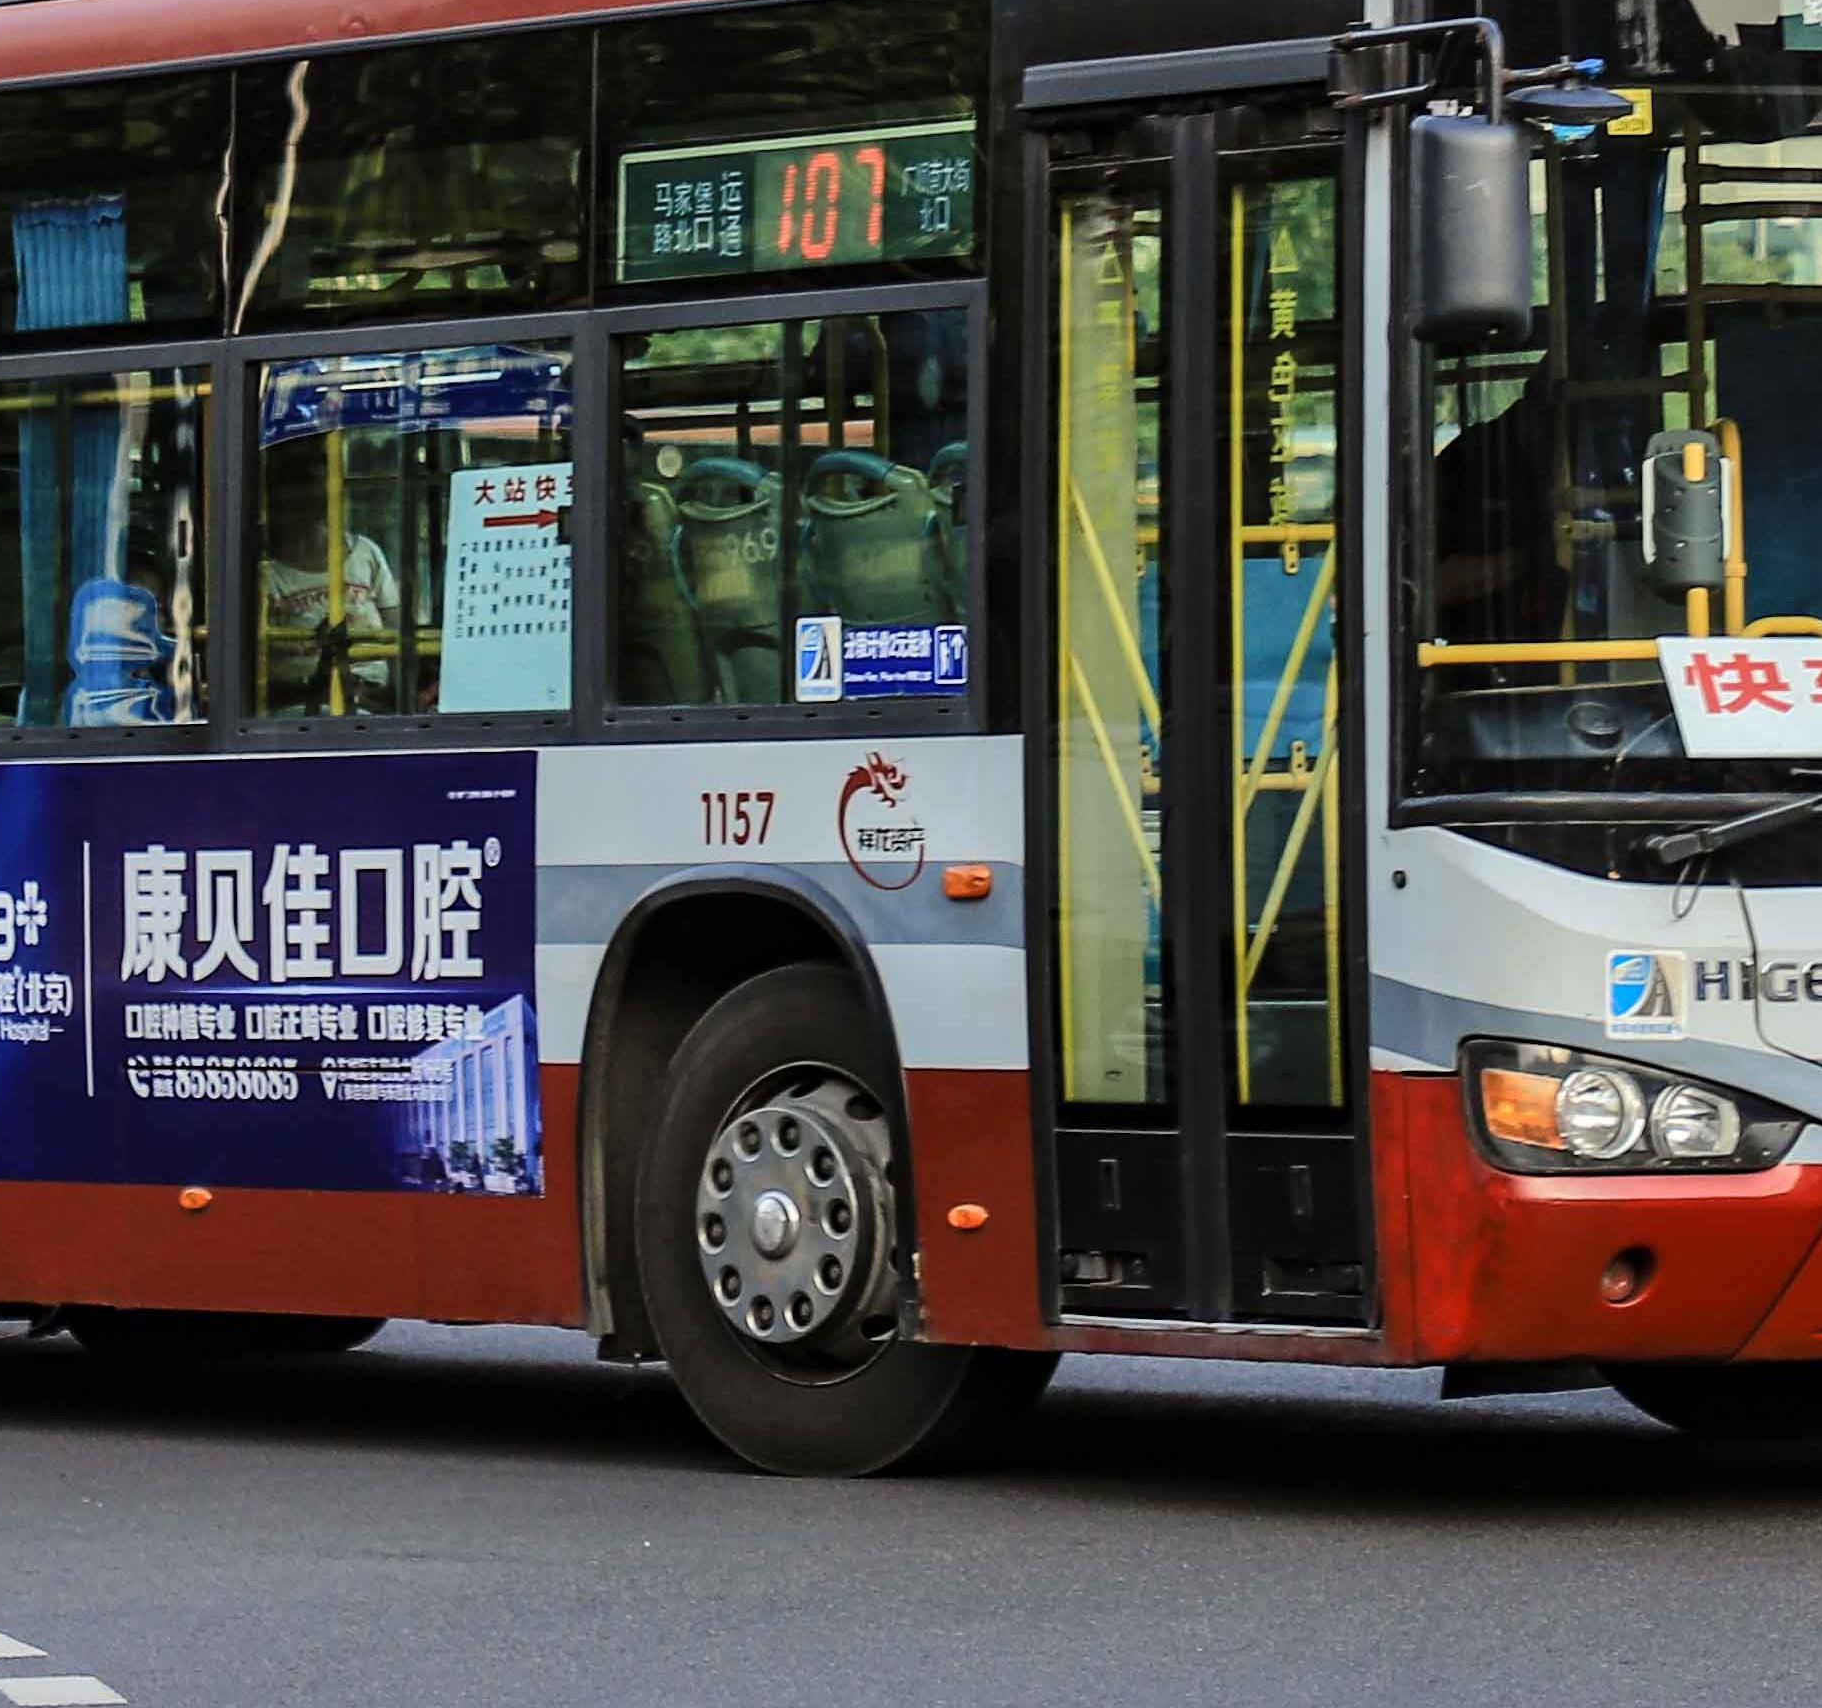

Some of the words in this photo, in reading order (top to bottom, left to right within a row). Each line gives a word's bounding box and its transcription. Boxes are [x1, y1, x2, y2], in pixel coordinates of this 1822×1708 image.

[654, 181, 714, 218] 马家堡
[778, 147, 886, 260] 107
[701, 792, 775, 846] 1157
[121, 840, 483, 984] 康贝佳口腔
